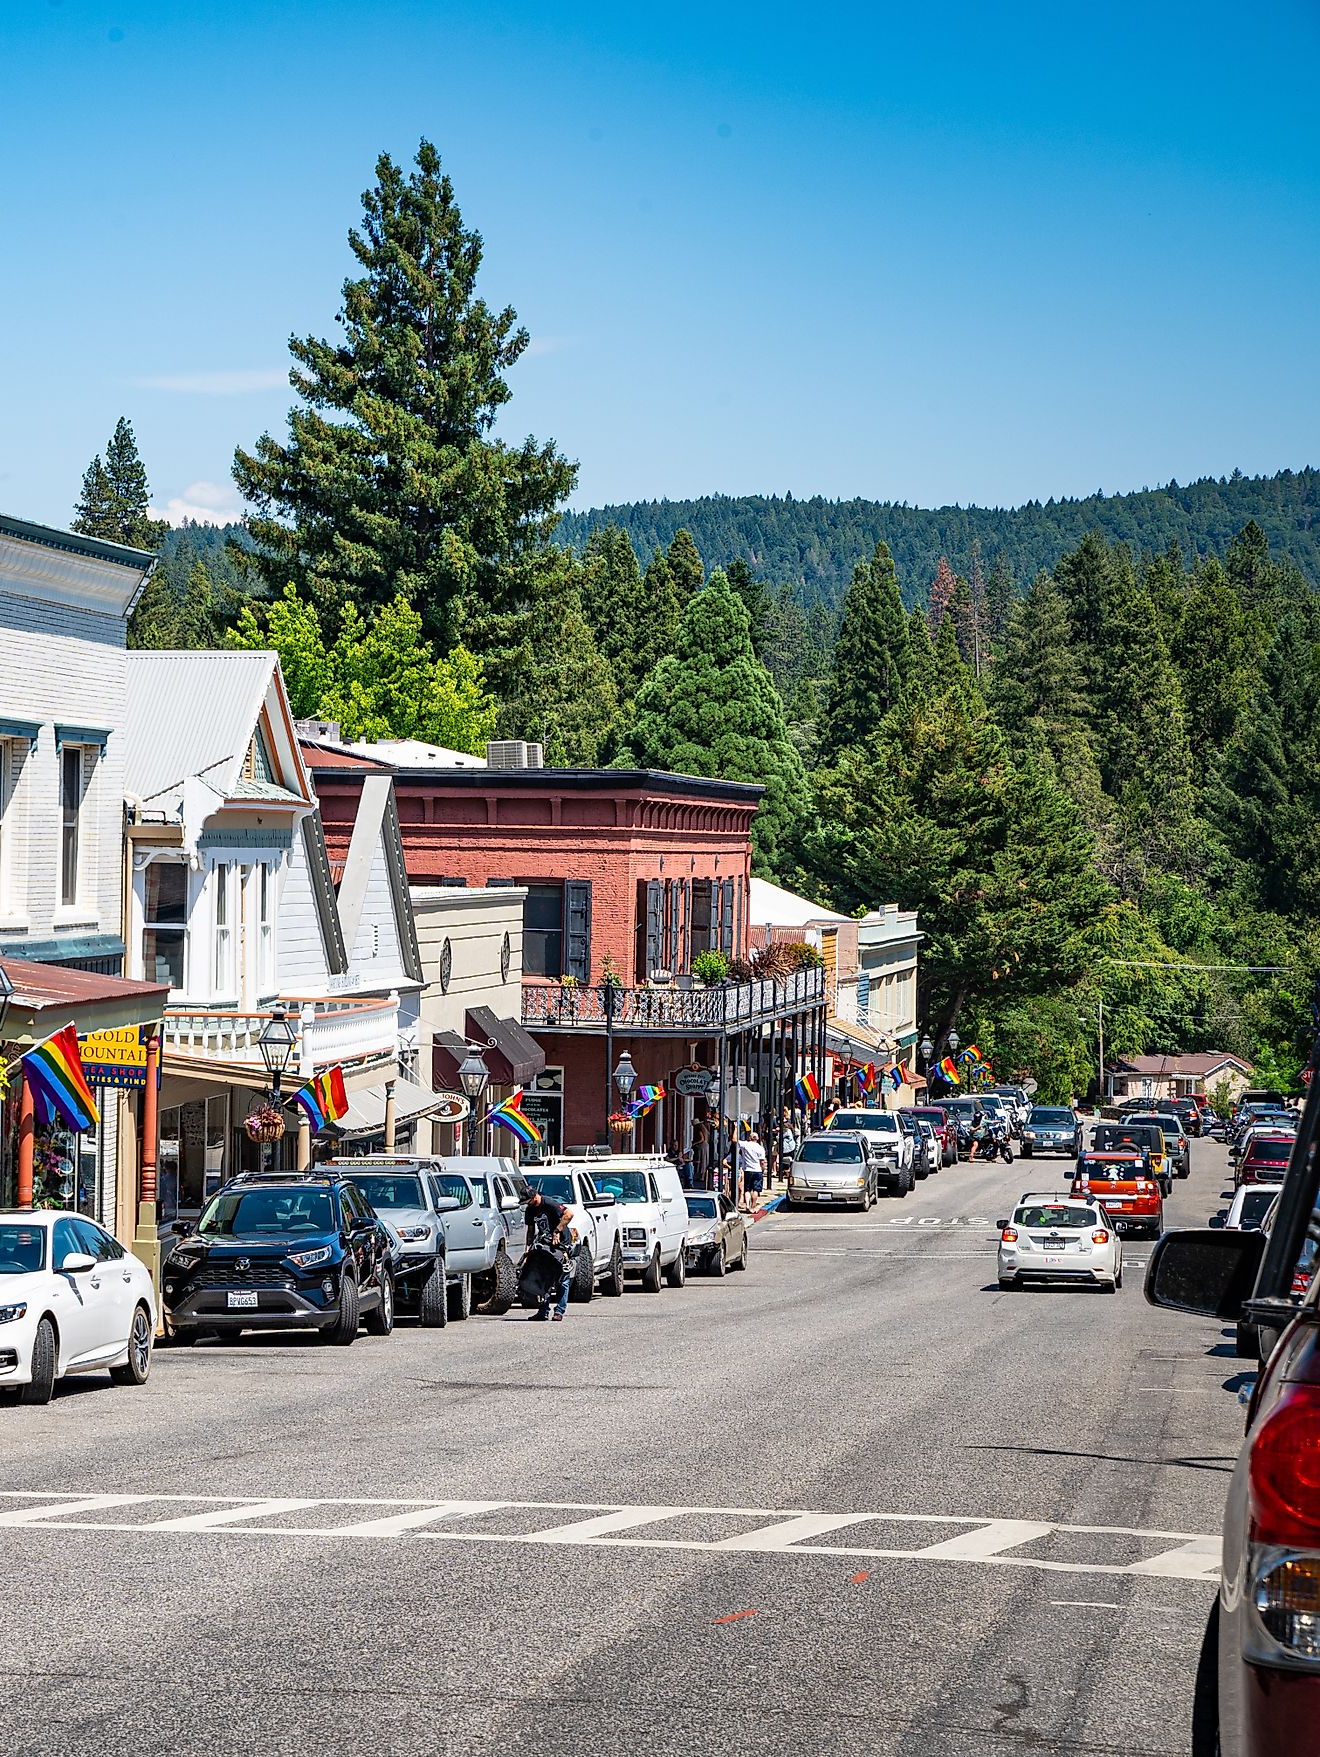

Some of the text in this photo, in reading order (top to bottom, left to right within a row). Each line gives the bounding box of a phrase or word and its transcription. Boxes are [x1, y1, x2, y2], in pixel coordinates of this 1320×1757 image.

[92, 1031, 135, 1043] GOLD
[80, 1046, 146, 1062] OUNTAI
[82, 1065, 143, 1076] TEA SHOP
[889, 1216, 989, 1225] STOP
